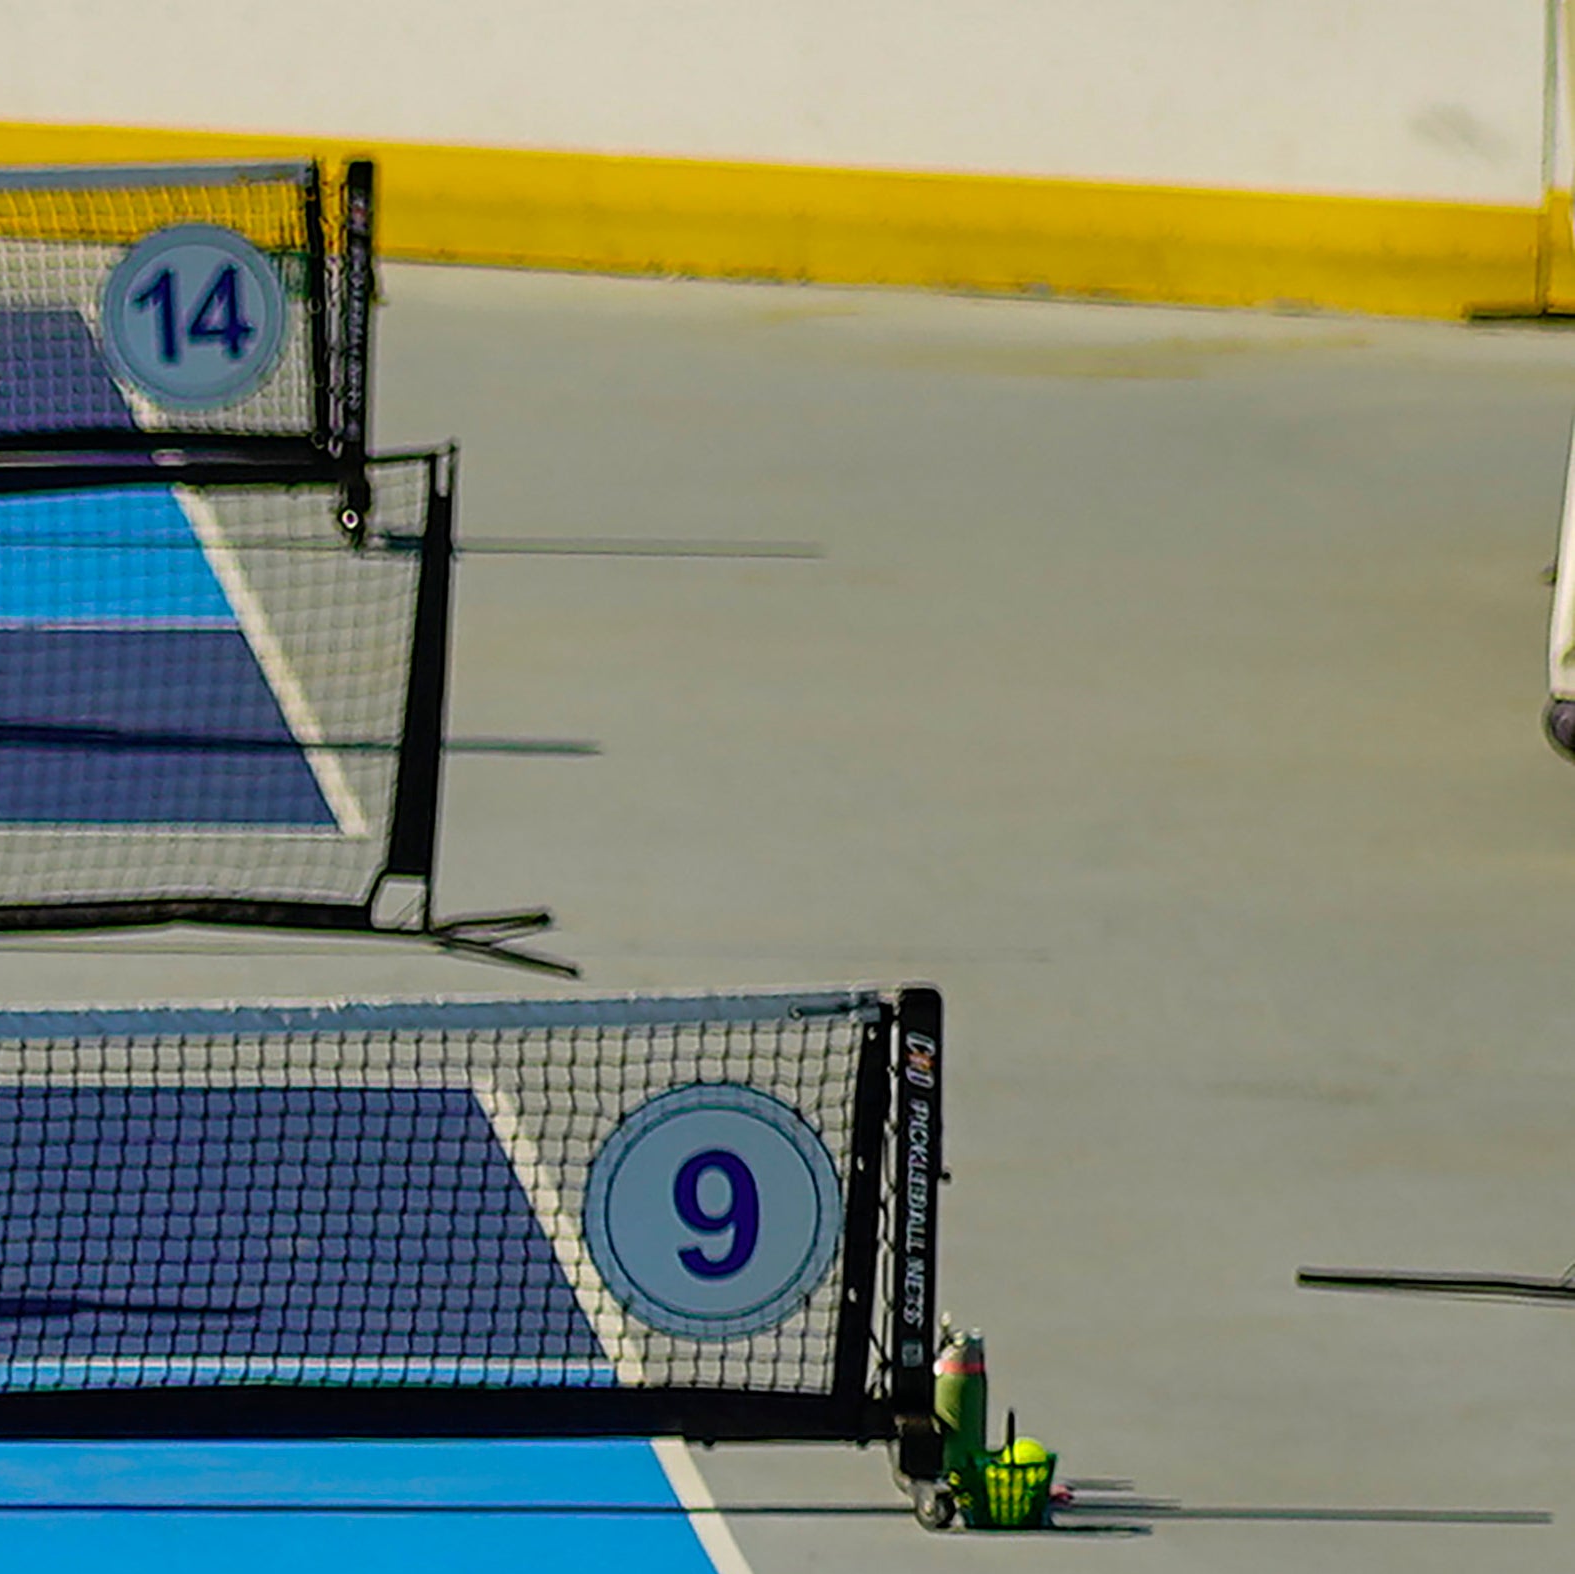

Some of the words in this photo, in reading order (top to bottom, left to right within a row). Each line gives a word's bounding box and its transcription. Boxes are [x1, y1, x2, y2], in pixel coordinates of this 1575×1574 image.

[131, 266, 256, 365] 14
[673, 1149, 760, 1281] 9
[905, 1098, 930, 1254] PICKLEBALL
[902, 1256, 926, 1328] NETS
